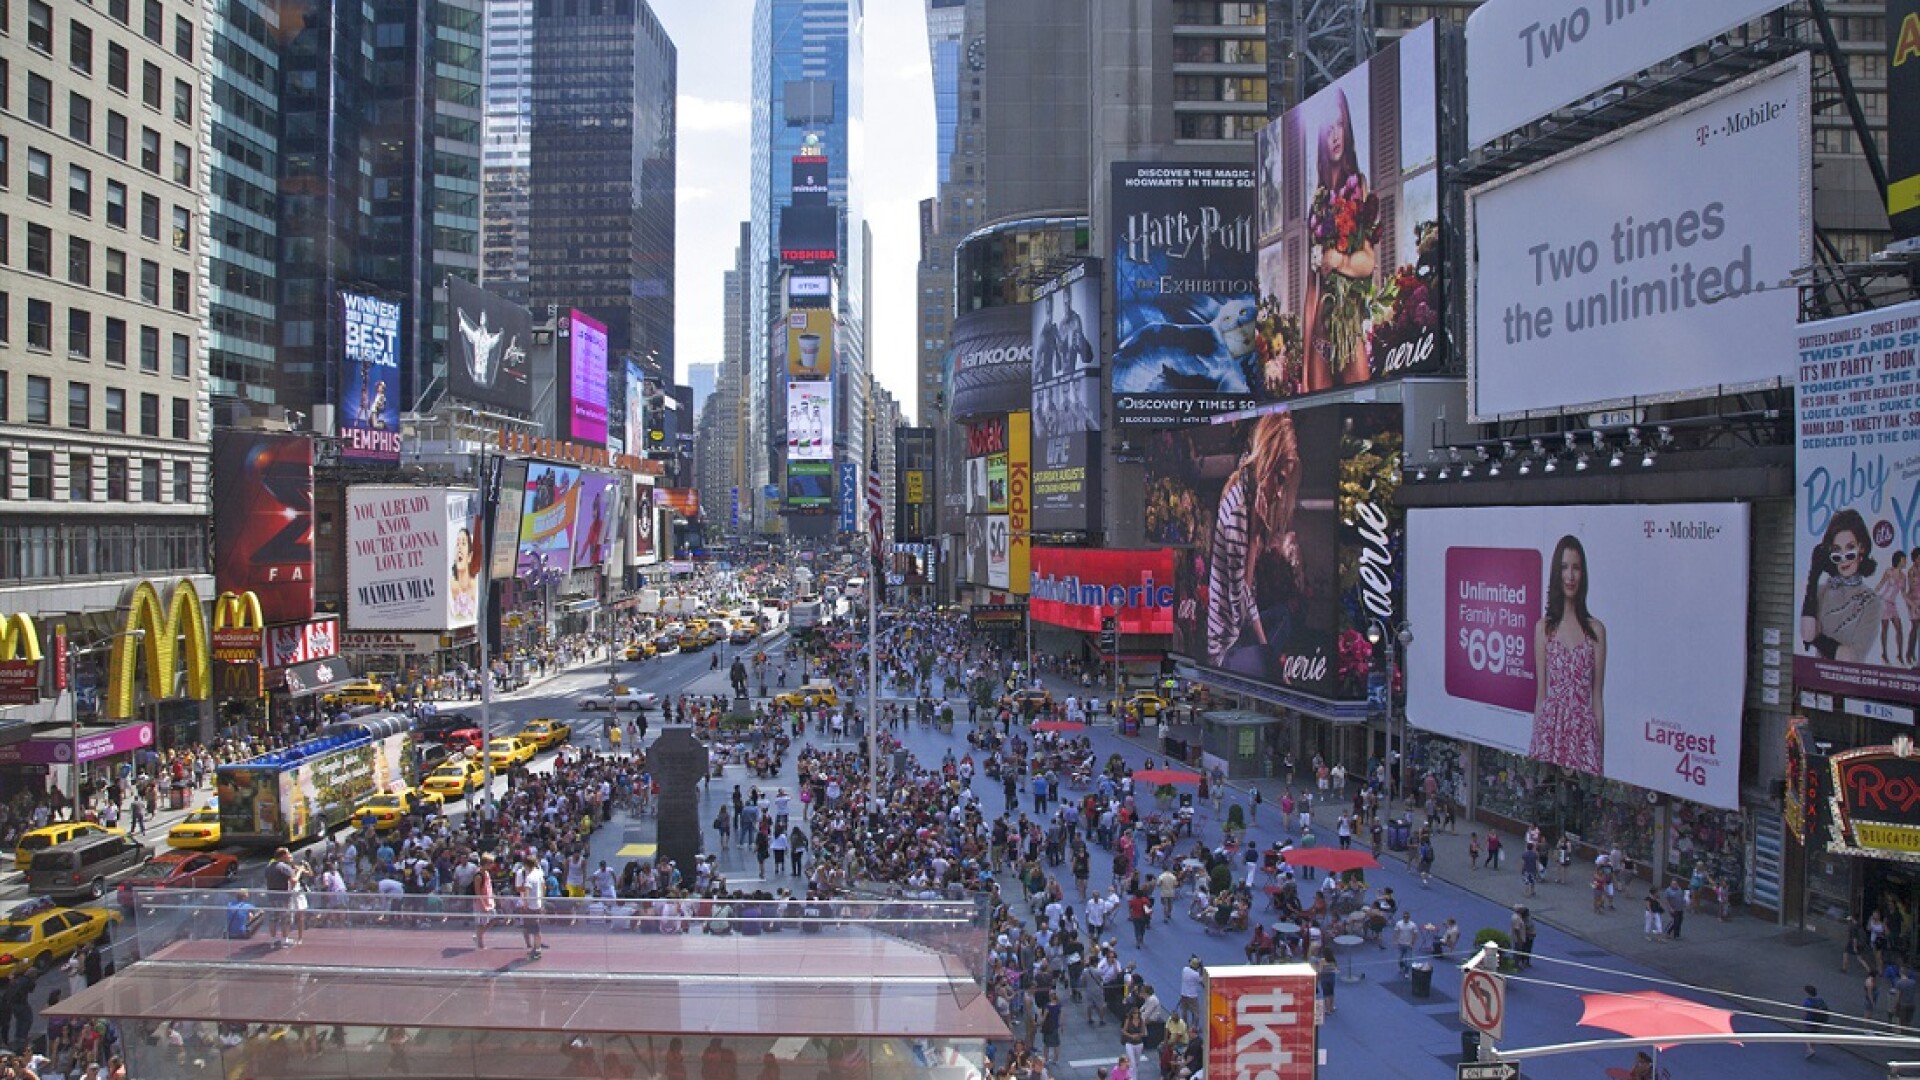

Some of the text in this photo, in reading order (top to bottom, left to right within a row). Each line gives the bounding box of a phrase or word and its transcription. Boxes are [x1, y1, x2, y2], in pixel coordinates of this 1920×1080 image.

[1518, 6, 1591, 68] Two
[807, 176, 814, 185] 5
[1125, 178, 1184, 188] HOGWARTS
[1187, 178, 1199, 187] IN
[1202, 179, 1233, 188] TIMES
[1137, 169, 1249, 178] DISCOVER THE MAGIC
[793, 184, 828, 192] minutes
[1121, 210, 1200, 264] Harry
[1529, 200, 1726, 286] Two times
[781, 250, 836, 260] TOSHIBA
[342, 292, 400, 320] WINNER!
[1503, 244, 1767, 345] the unlimited.
[345, 321, 397, 353] BEST
[1384, 326, 1435, 372] aerie
[1800, 344, 1854, 363] TWIST
[1858, 337, 1896, 354] AND
[345, 345, 397, 368] MUSICAL
[1800, 348, 1916, 382] IT'S MY PARTY BOOK
[1800, 370, 1911, 395] TONIGHT'S THE
[1122, 396, 1194, 413] Discovery
[1198, 399, 1236, 411] TIMES
[1802, 407, 1832, 420] LOUIE
[1834, 404, 1868, 418] LOUIE
[1879, 398, 1912, 412] DUKE
[341, 427, 401, 453] MEMPHIS
[1802, 435, 1858, 449] DEDICATED
[1859, 433, 1874, 446] TO
[1877, 430, 1899, 444] THE
[1011, 461, 1029, 547] Kodak
[1803, 450, 1891, 538] Baby
[354, 502, 376, 520] YOU
[381, 495, 430, 517] ALREADY
[377, 516, 411, 536] KNOW
[356, 530, 439, 556] YOU'RE GONNA
[375, 550, 424, 572] LOVE IT!
[1356, 501, 1393, 617] aerie
[358, 577, 435, 606] MAMMA MIA!
[1460, 581, 1526, 604] Unlimited
[1460, 604, 1526, 628] Family Plan
[1284, 647, 1328, 682] aerie
[1645, 722, 1716, 754] Largest
[1675, 752, 1706, 786] 4G
